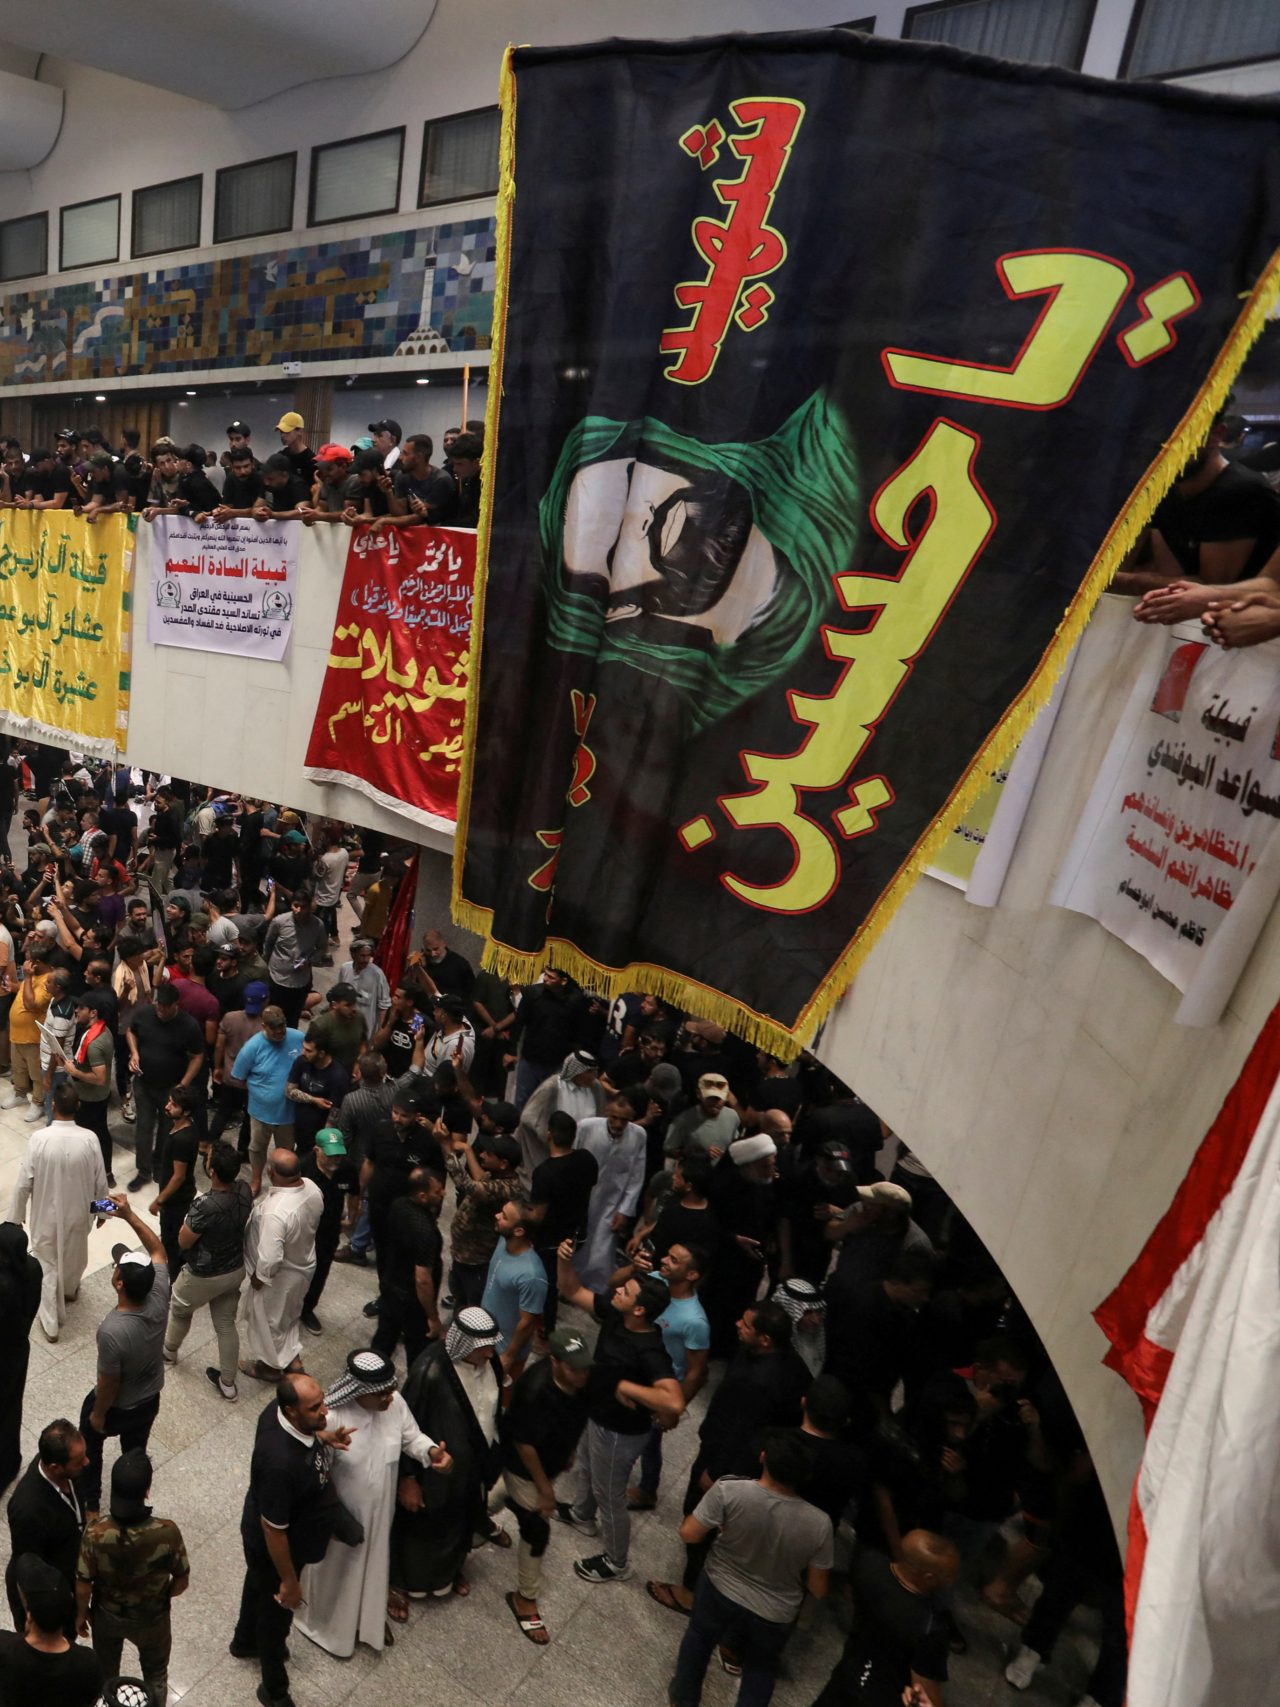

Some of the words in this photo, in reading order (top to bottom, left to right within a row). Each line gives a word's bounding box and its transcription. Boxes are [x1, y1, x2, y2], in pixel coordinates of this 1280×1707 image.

[660, 96, 806, 385] شهيد
[881, 247, 1200, 411] يا
[387, 532, 400, 565] يا
[165, 555, 205, 578] النعيم
[208, 555, 248, 578] السادة
[448, 546, 462, 581] يا
[252, 557, 287, 586] قبيلة
[189, 587, 210, 600] العراق
[210, 590, 222, 603] في
[223, 591, 253, 605] الحسينية
[180, 603, 197, 614] الصدر
[197, 606, 221, 616] مقتدى
[221, 607, 241, 619] السيد
[241, 609, 261, 621] تساند
[162, 615, 195, 628] والمفسدين
[195, 618, 214, 629] الفساد
[214, 620, 224, 629] ضد
[253, 625, 270, 637] ثورته
[269, 628, 282, 639] في
[680, 415, 997, 916] حسين
[1201, 694, 1258, 748] قبيلة
[1165, 858, 1235, 911] ظاهراتهم
